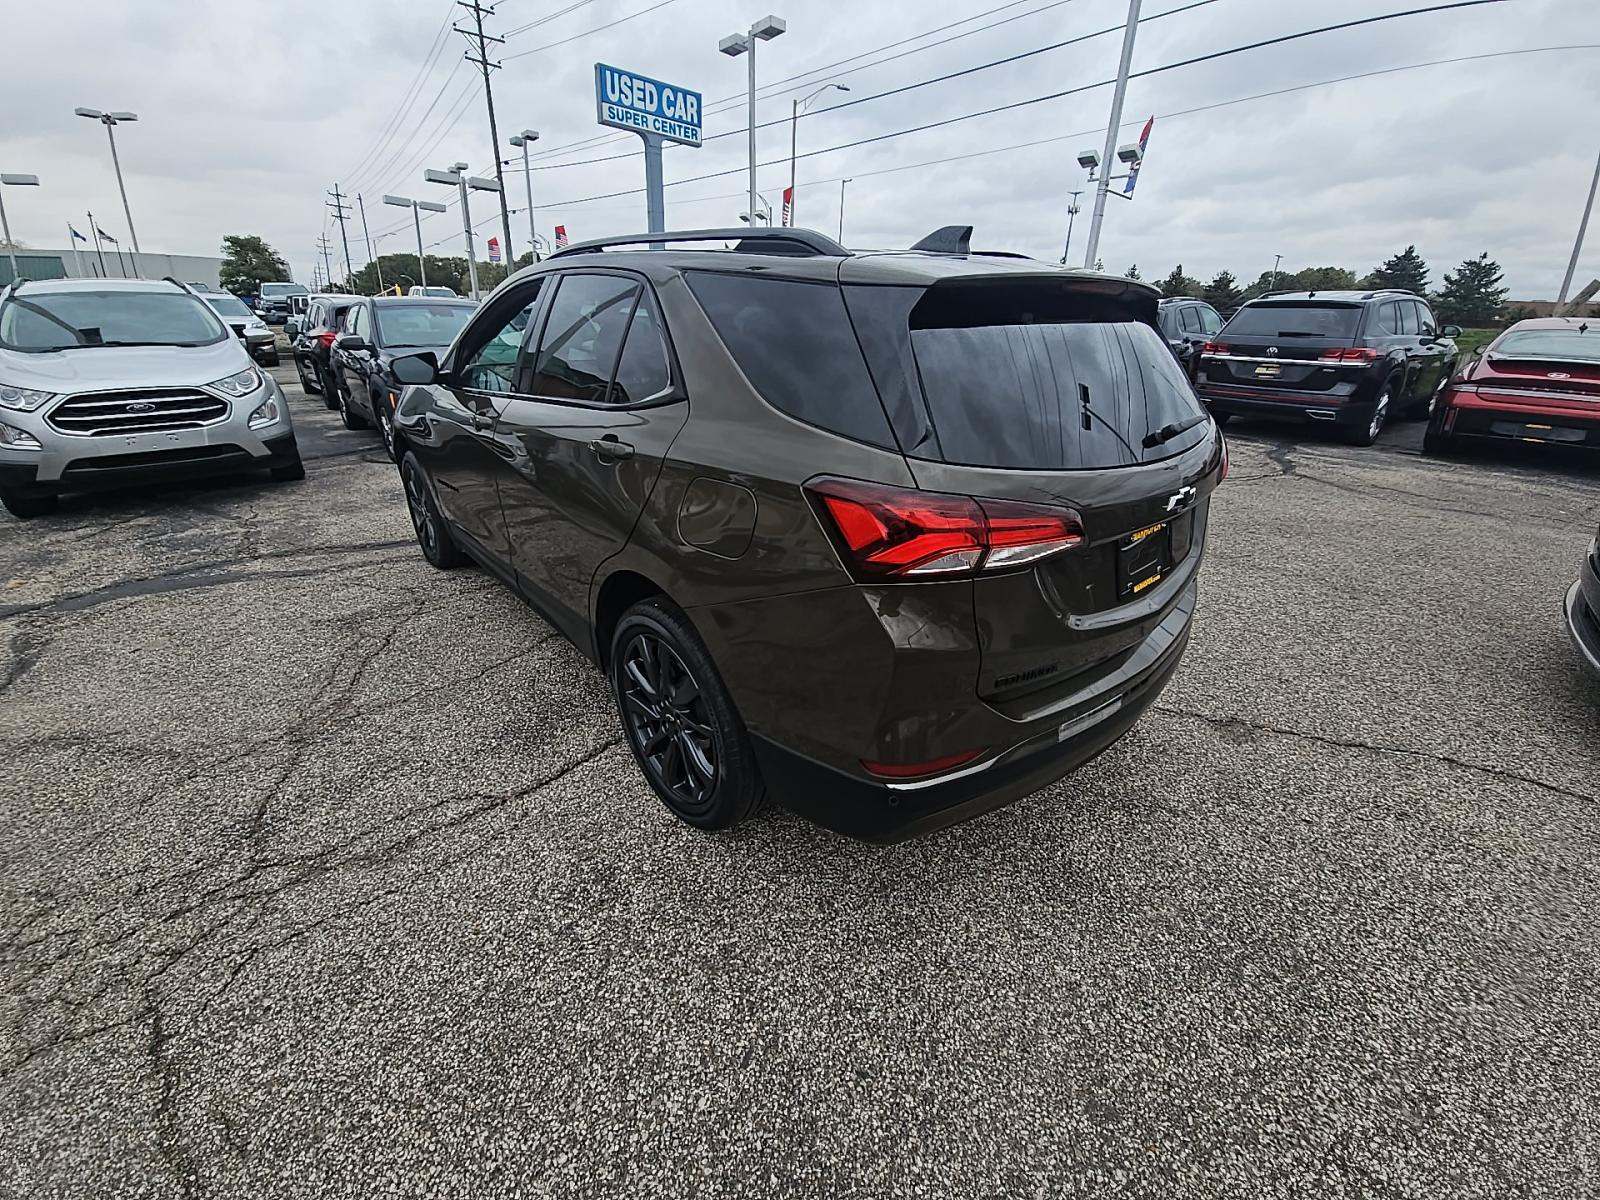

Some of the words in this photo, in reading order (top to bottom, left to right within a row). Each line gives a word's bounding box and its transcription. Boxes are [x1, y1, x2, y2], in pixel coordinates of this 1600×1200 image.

[606, 70, 658, 112] USED
[662, 87, 698, 124] CAR
[608, 106, 649, 128] SUPER
[653, 118, 698, 140] CENTER
